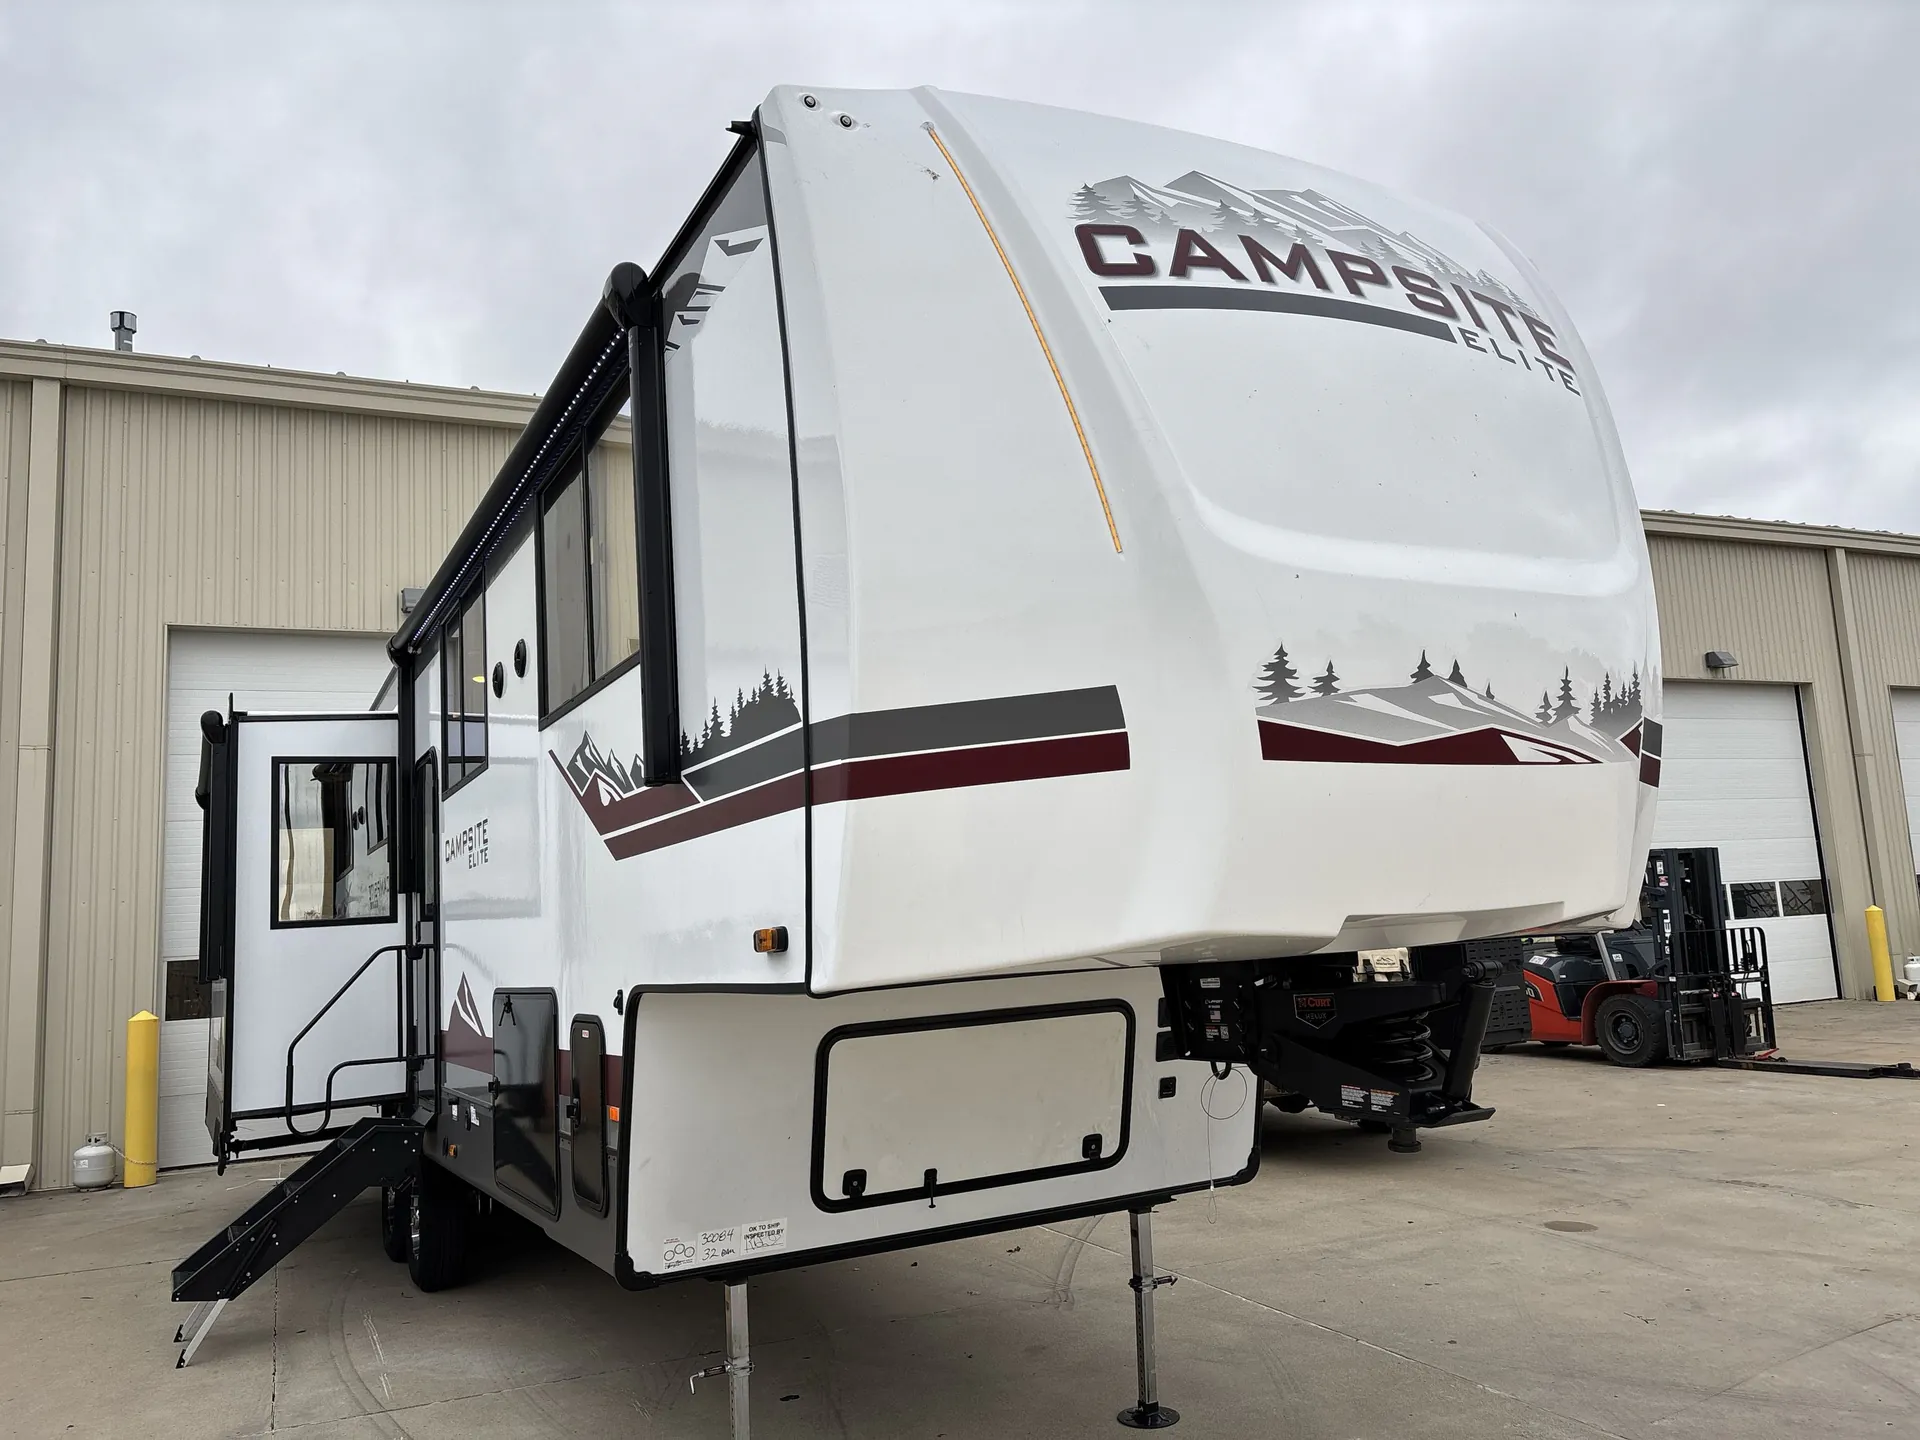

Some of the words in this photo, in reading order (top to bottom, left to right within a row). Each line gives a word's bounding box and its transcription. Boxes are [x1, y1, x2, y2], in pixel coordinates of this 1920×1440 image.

[1074, 223, 1574, 373] CAMPSITE
[1457, 326, 1582, 396] ELITE
[445, 818, 489, 863] CAMPSITE
[468, 847, 489, 870] ELITE
[1307, 997, 1331, 1007] CURT
[744, 1230, 776, 1240] INSPECTED
[776, 1228, 785, 1236] BY
[702, 1248, 719, 1261] 32
